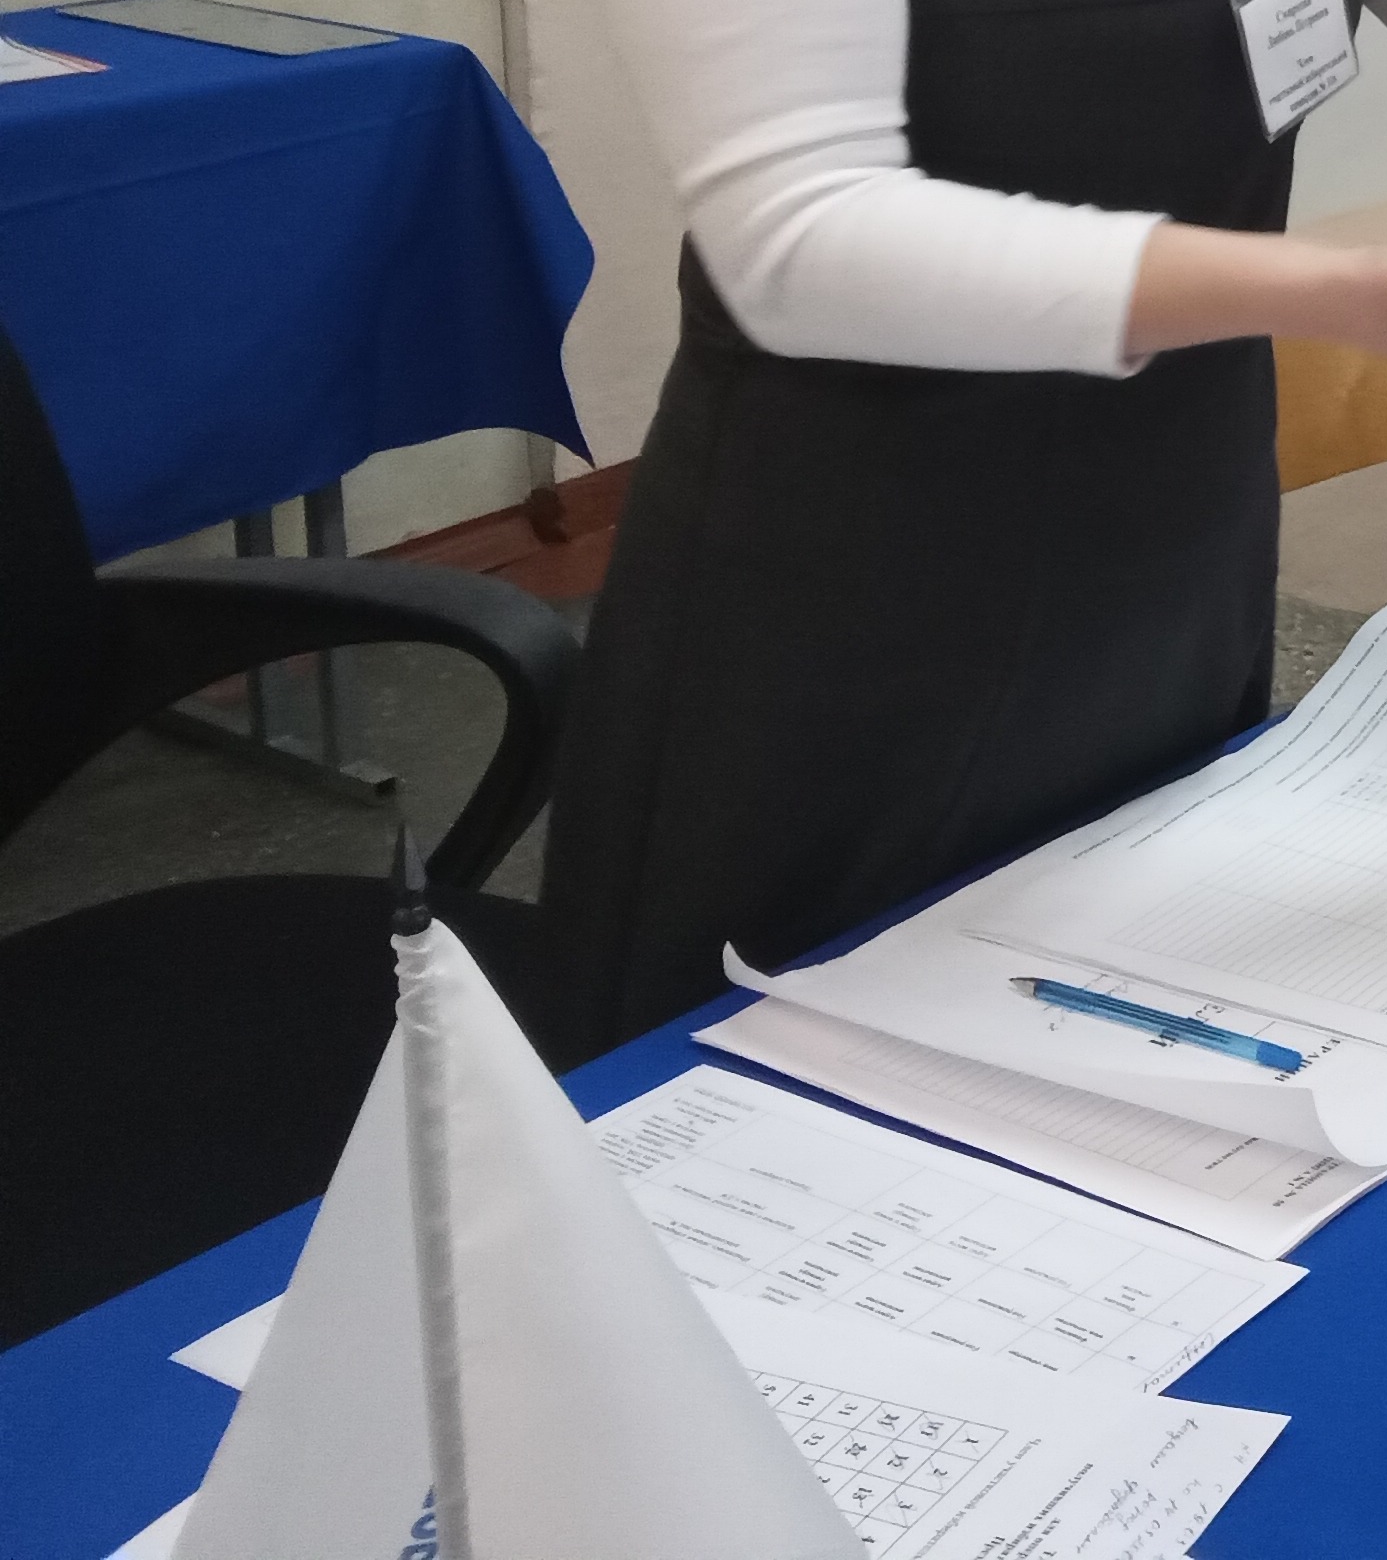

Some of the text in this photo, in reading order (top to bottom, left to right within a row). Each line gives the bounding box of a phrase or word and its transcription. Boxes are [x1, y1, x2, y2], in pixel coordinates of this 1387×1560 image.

[797, 1394, 815, 1406] 41
[803, 1403, 858, 1446] 31 32
